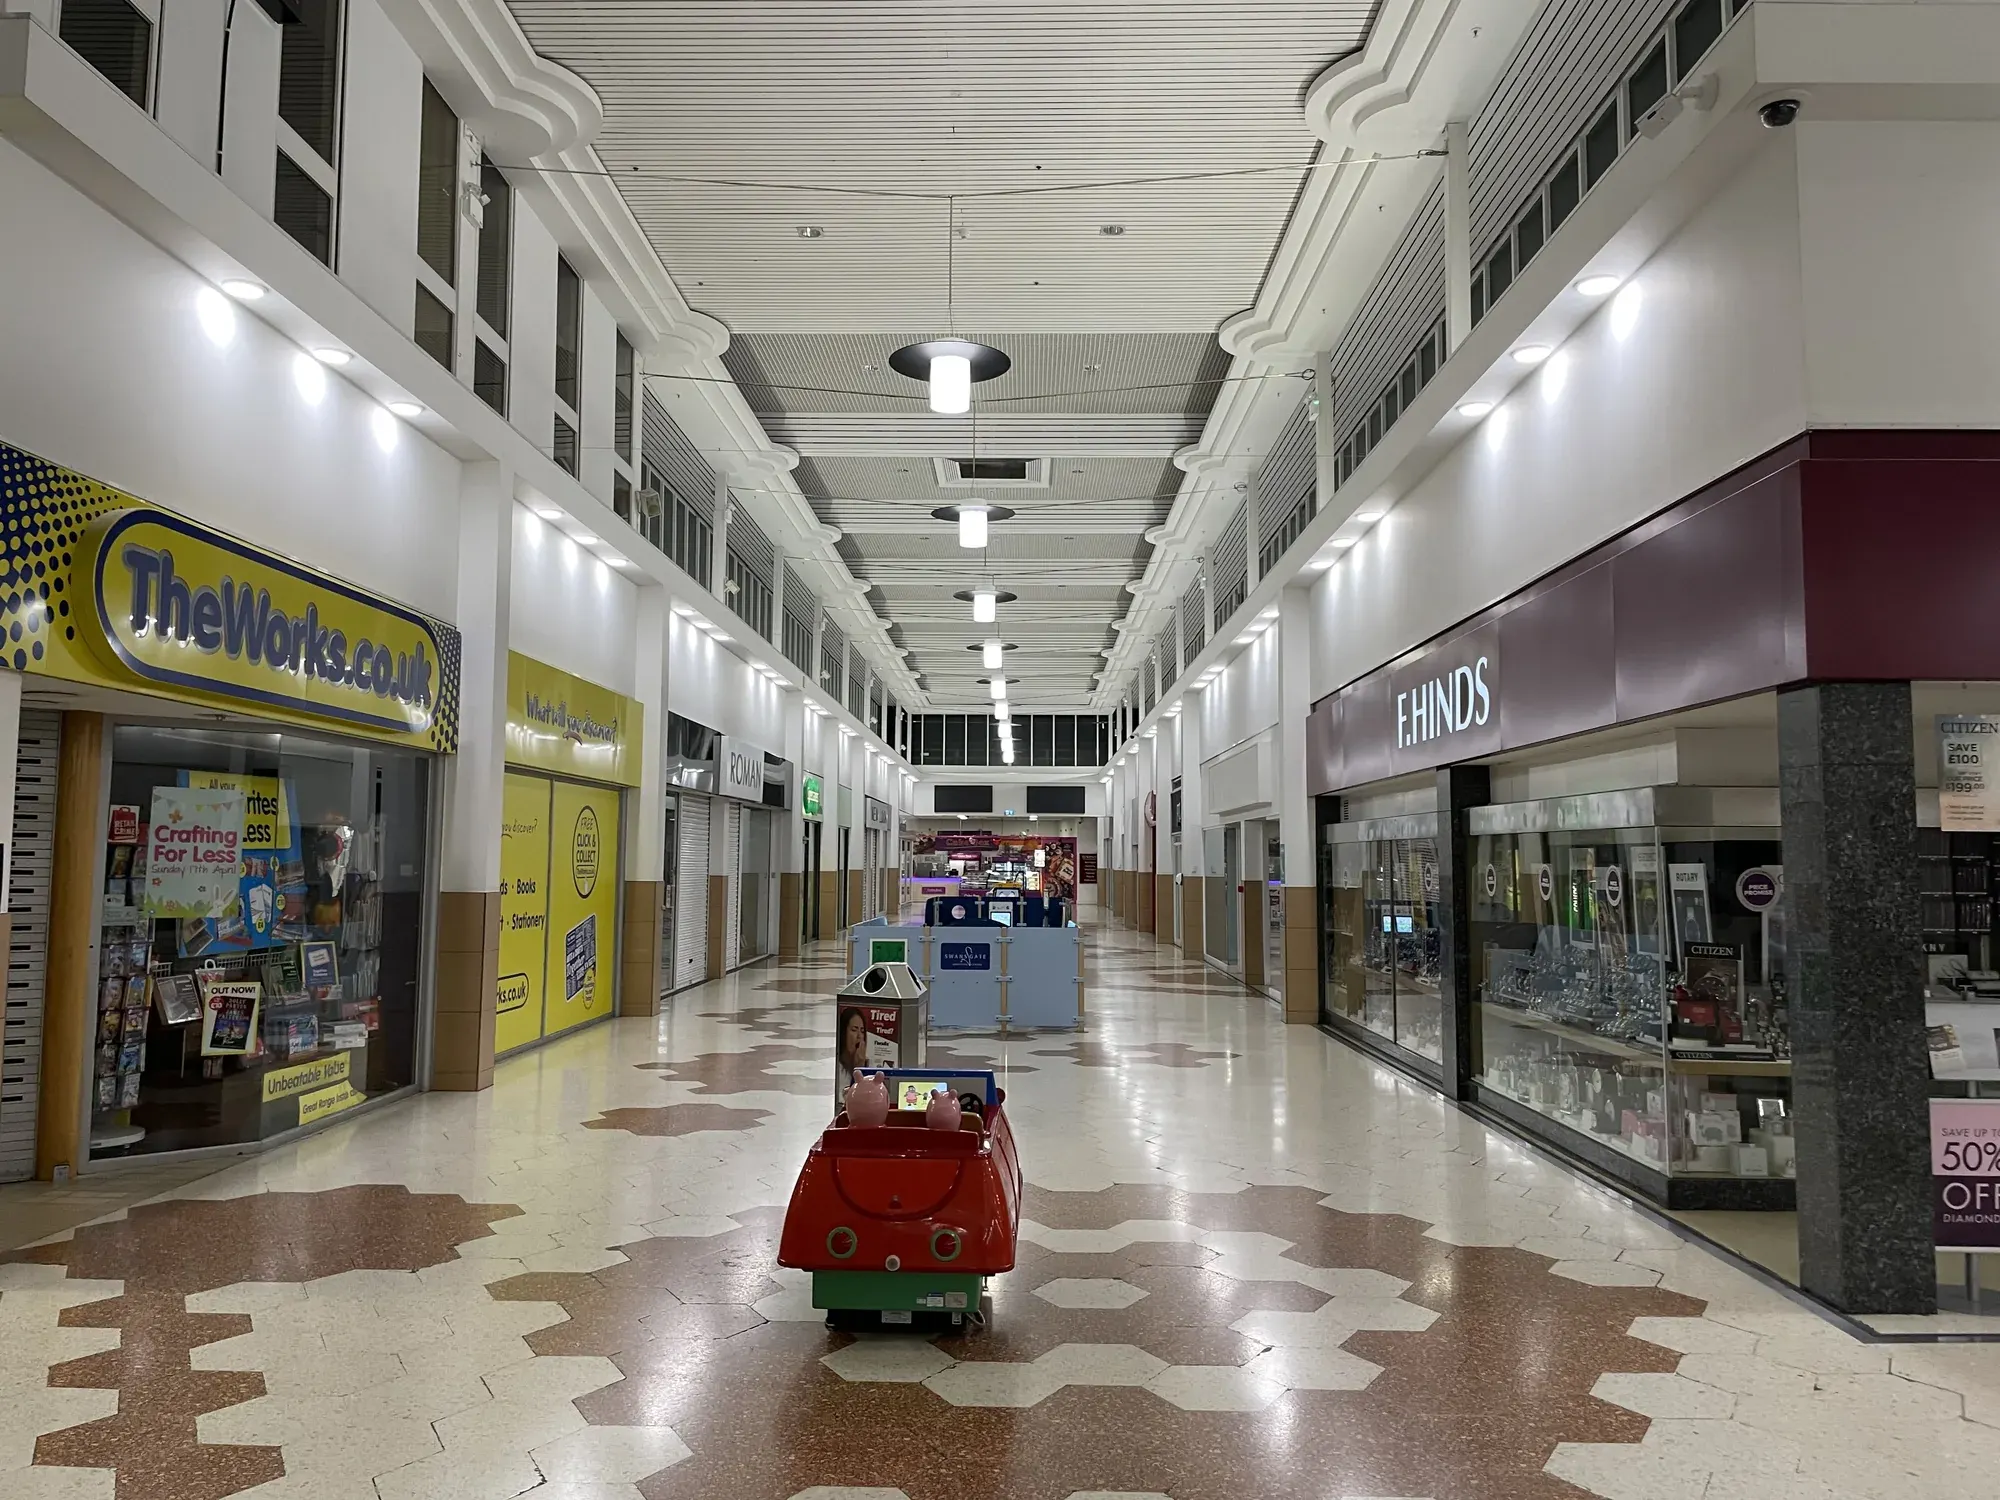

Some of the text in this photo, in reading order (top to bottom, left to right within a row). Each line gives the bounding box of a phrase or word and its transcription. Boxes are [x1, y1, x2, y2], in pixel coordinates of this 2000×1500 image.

[122, 542, 431, 709] TheWorks.co.uk
[526, 691, 551, 724] What
[552, 700, 566, 728] will
[1397, 656, 1490, 749] F.HINDS
[1940, 722, 1999, 734] CITIZEN
[1947, 743, 1978, 752] SAVE
[1948, 754, 1979, 765] £100
[730, 751, 762, 789] ROMAN
[512, 818, 538, 834] discover?
[580, 816, 594, 830] FREE
[154, 824, 238, 848] Crafting
[576, 834, 597, 847] CLICK &
[154, 845, 237, 863] For Less
[576, 850, 596, 863] COLLECT
[151, 864, 185, 879] Sunday
[212, 864, 237, 879] April
[1675, 871, 1698, 882] ROTARY
[516, 878, 536, 894] Books
[512, 911, 546, 930] Stationery
[1691, 945, 1734, 956] CITIZEN
[211, 986, 257, 995] OUT NOW!
[870, 1009, 897, 1022] Tired
[876, 1027, 895, 1035] Tired?
[1676, 1051, 1713, 1059] CITIZEN
[268, 1061, 345, 1095] Unbeatable Value
[302, 1102, 318, 1114] Great
[318, 1098, 335, 1109] Range
[1941, 1127, 1970, 1138] SAVE
[1973, 1128, 1988, 1138] UP
[1941, 1141, 2000, 1172] 50%
